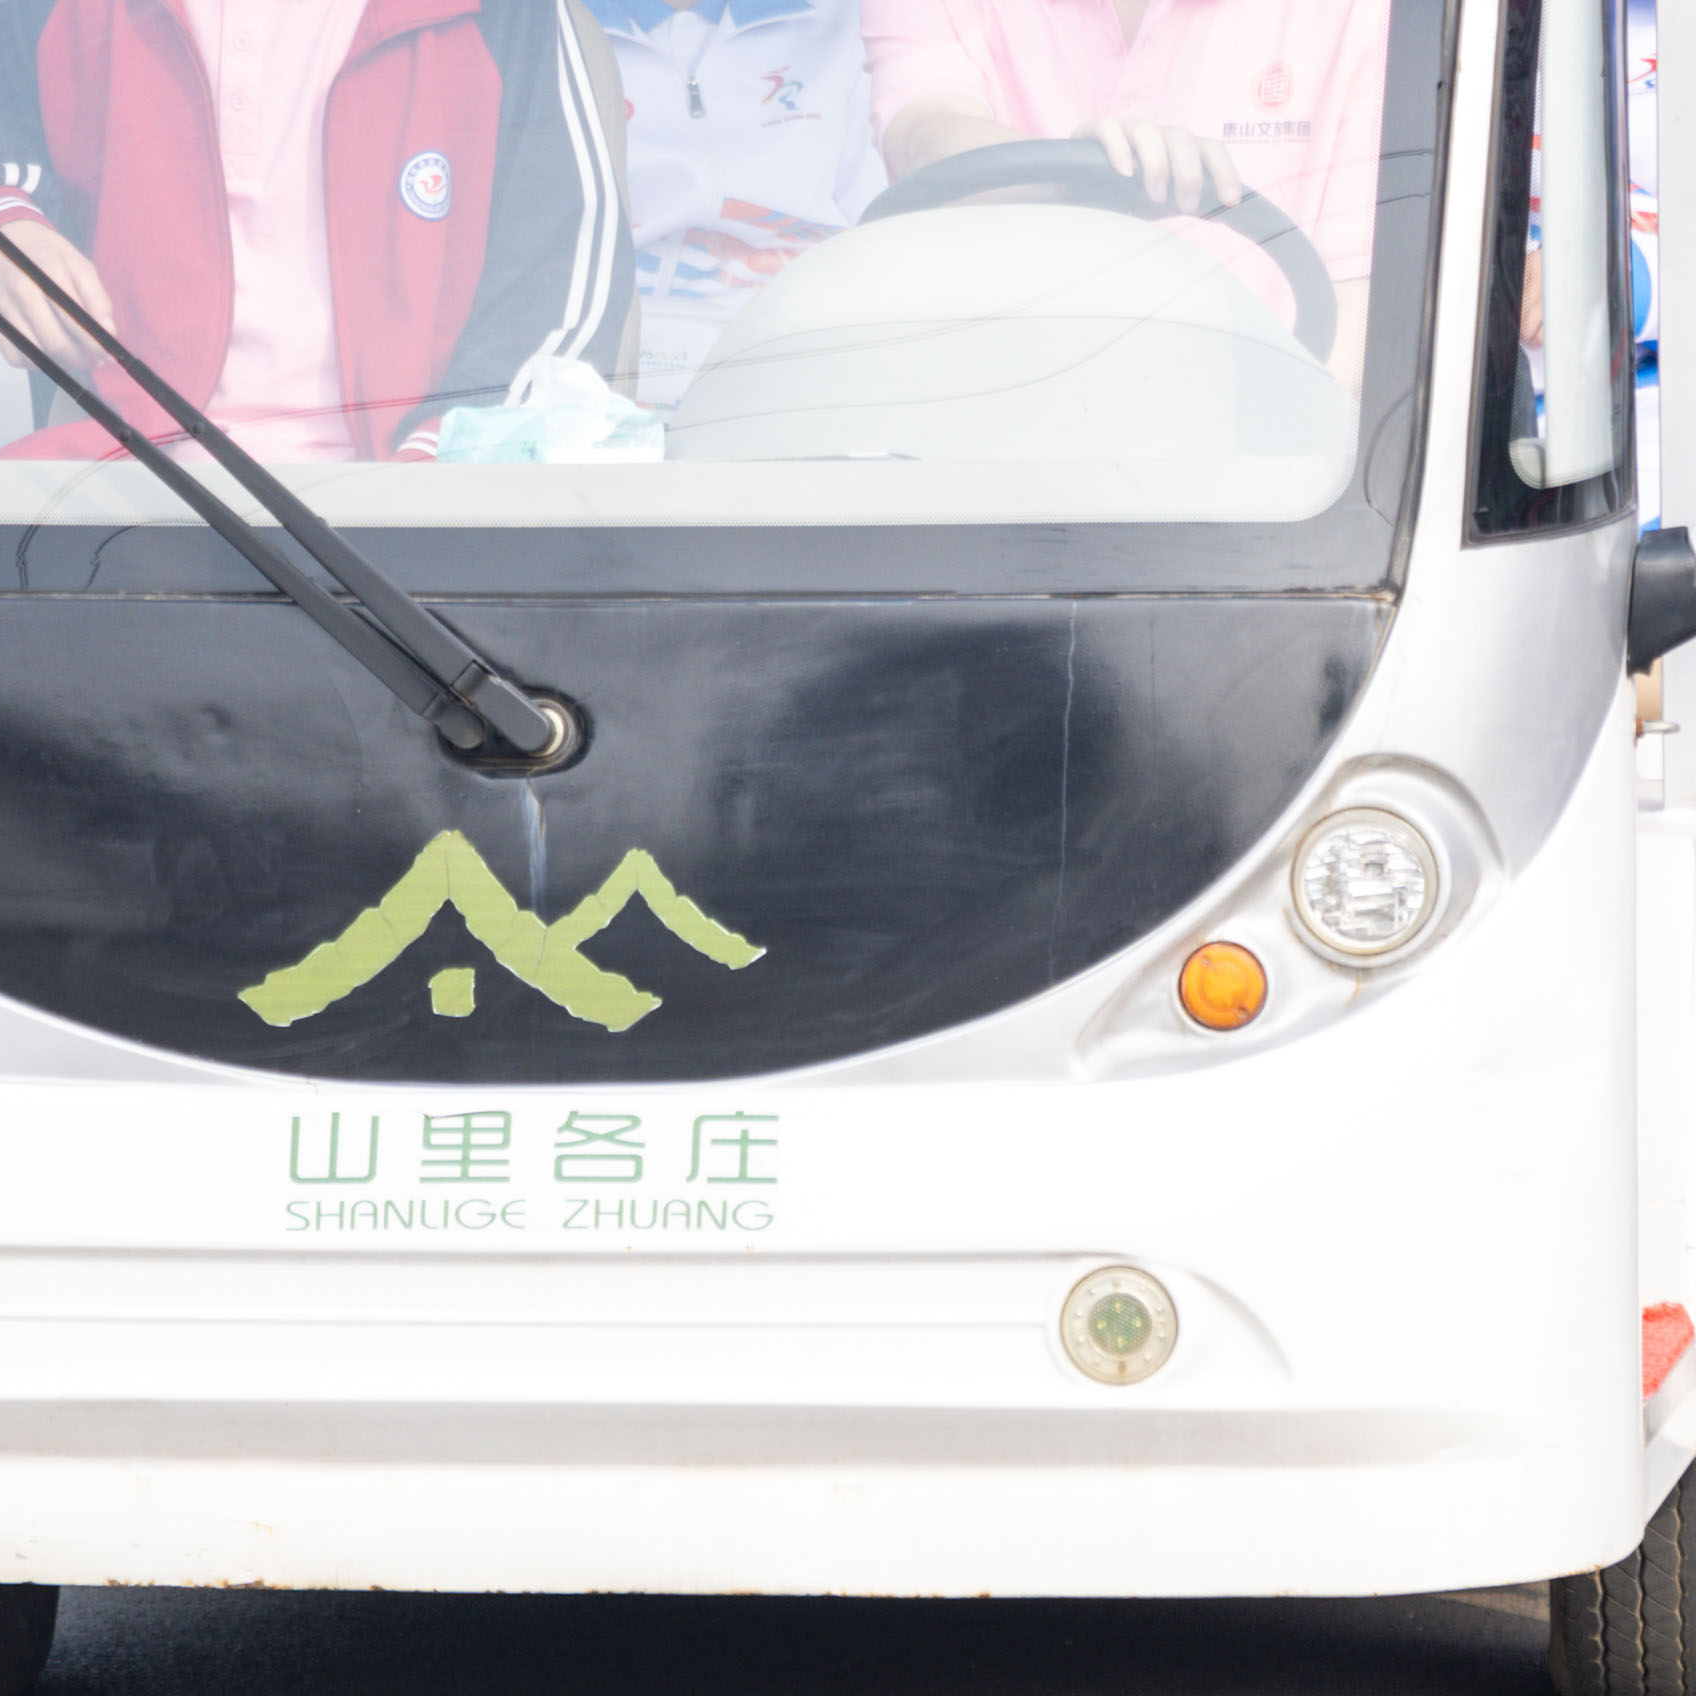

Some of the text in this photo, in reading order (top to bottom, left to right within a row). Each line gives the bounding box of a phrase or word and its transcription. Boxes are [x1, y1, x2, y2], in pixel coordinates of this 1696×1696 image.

[288, 1110, 780, 1185] 山里各庄
[285, 1197, 775, 1232] SHANLIGE ZHUANG
